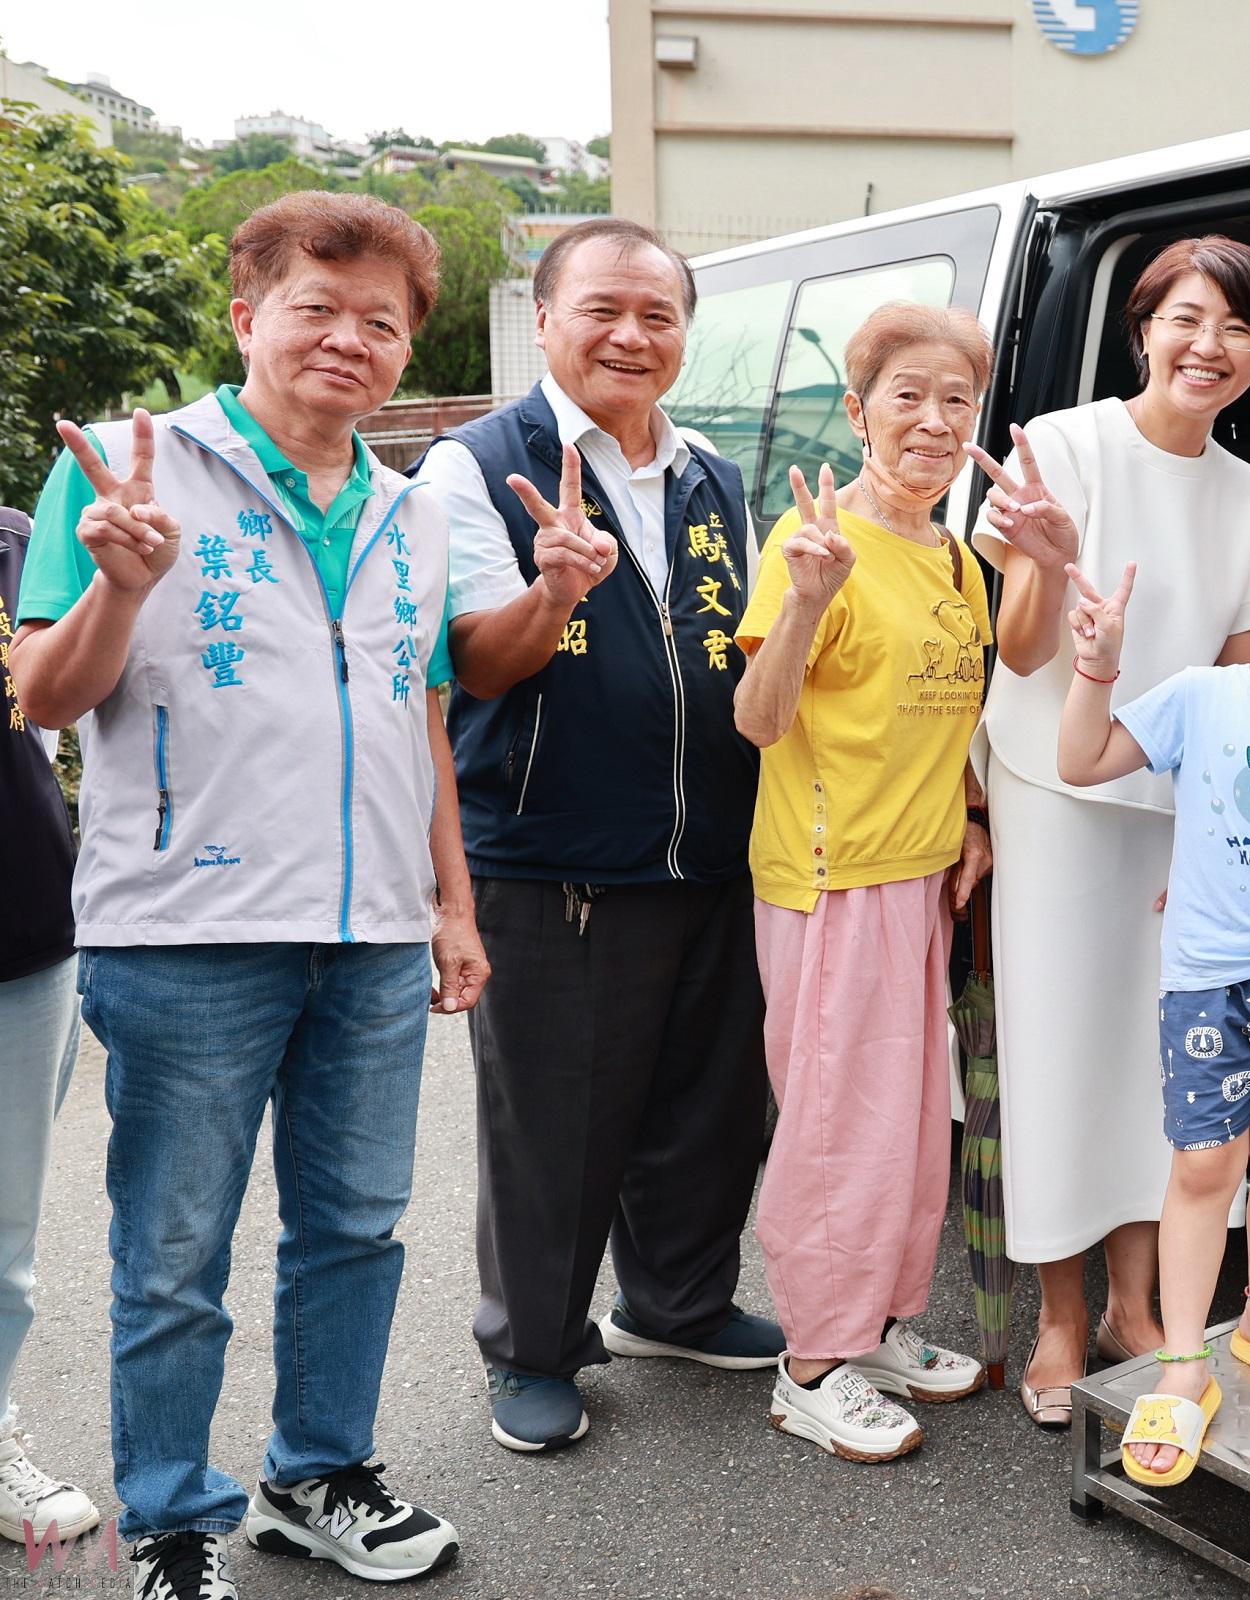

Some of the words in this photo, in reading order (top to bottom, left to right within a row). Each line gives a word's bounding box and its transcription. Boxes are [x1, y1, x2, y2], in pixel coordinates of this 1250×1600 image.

[236, 508, 280, 584] 鄉長
[688, 524, 733, 672] 馬文君
[193, 534, 245, 689] 葉銘豐
[385, 522, 418, 711] 水里鄉公所
[919, 690, 938, 701] KEEP
[928, 705, 943, 716] THE
